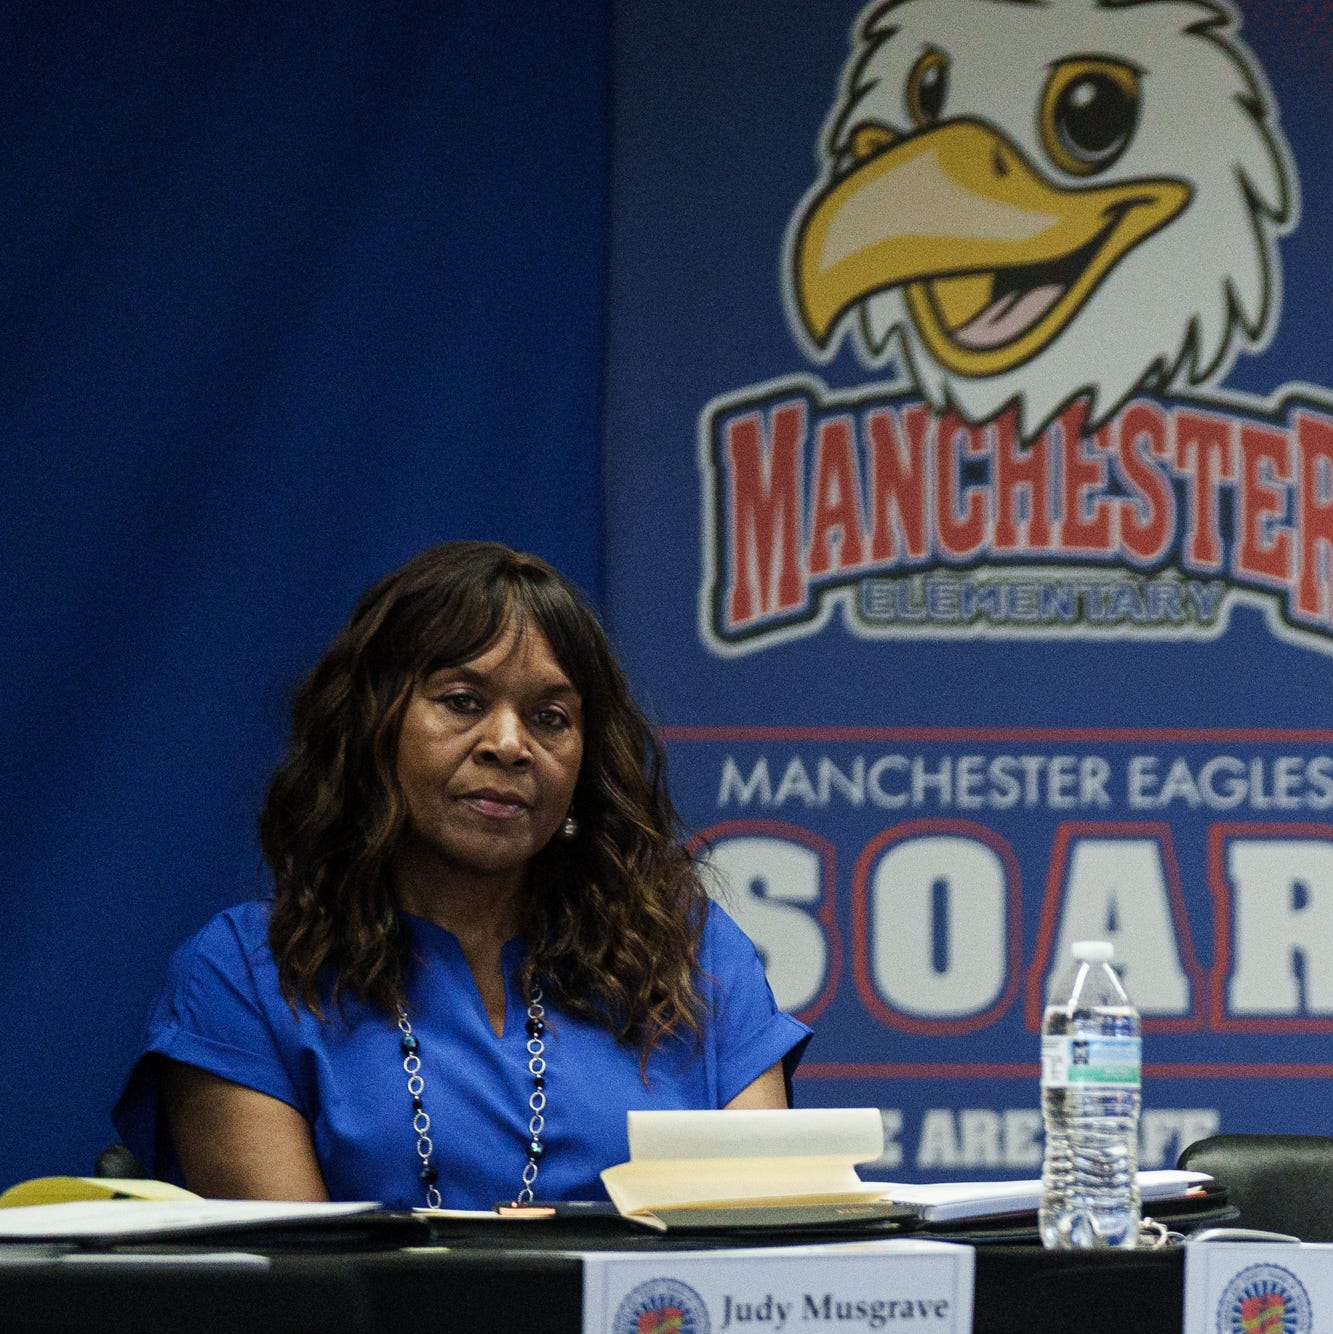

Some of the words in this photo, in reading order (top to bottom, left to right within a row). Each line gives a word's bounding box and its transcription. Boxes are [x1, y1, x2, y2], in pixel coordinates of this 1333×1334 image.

[862, 579, 1225, 622] ELEMENTARY
[717, 755, 1110, 809] MANCHESTER
[917, 1108, 1045, 1169] ARE
[721, 1295, 793, 1330] Judy
[800, 1294, 949, 1329] Musgrave
